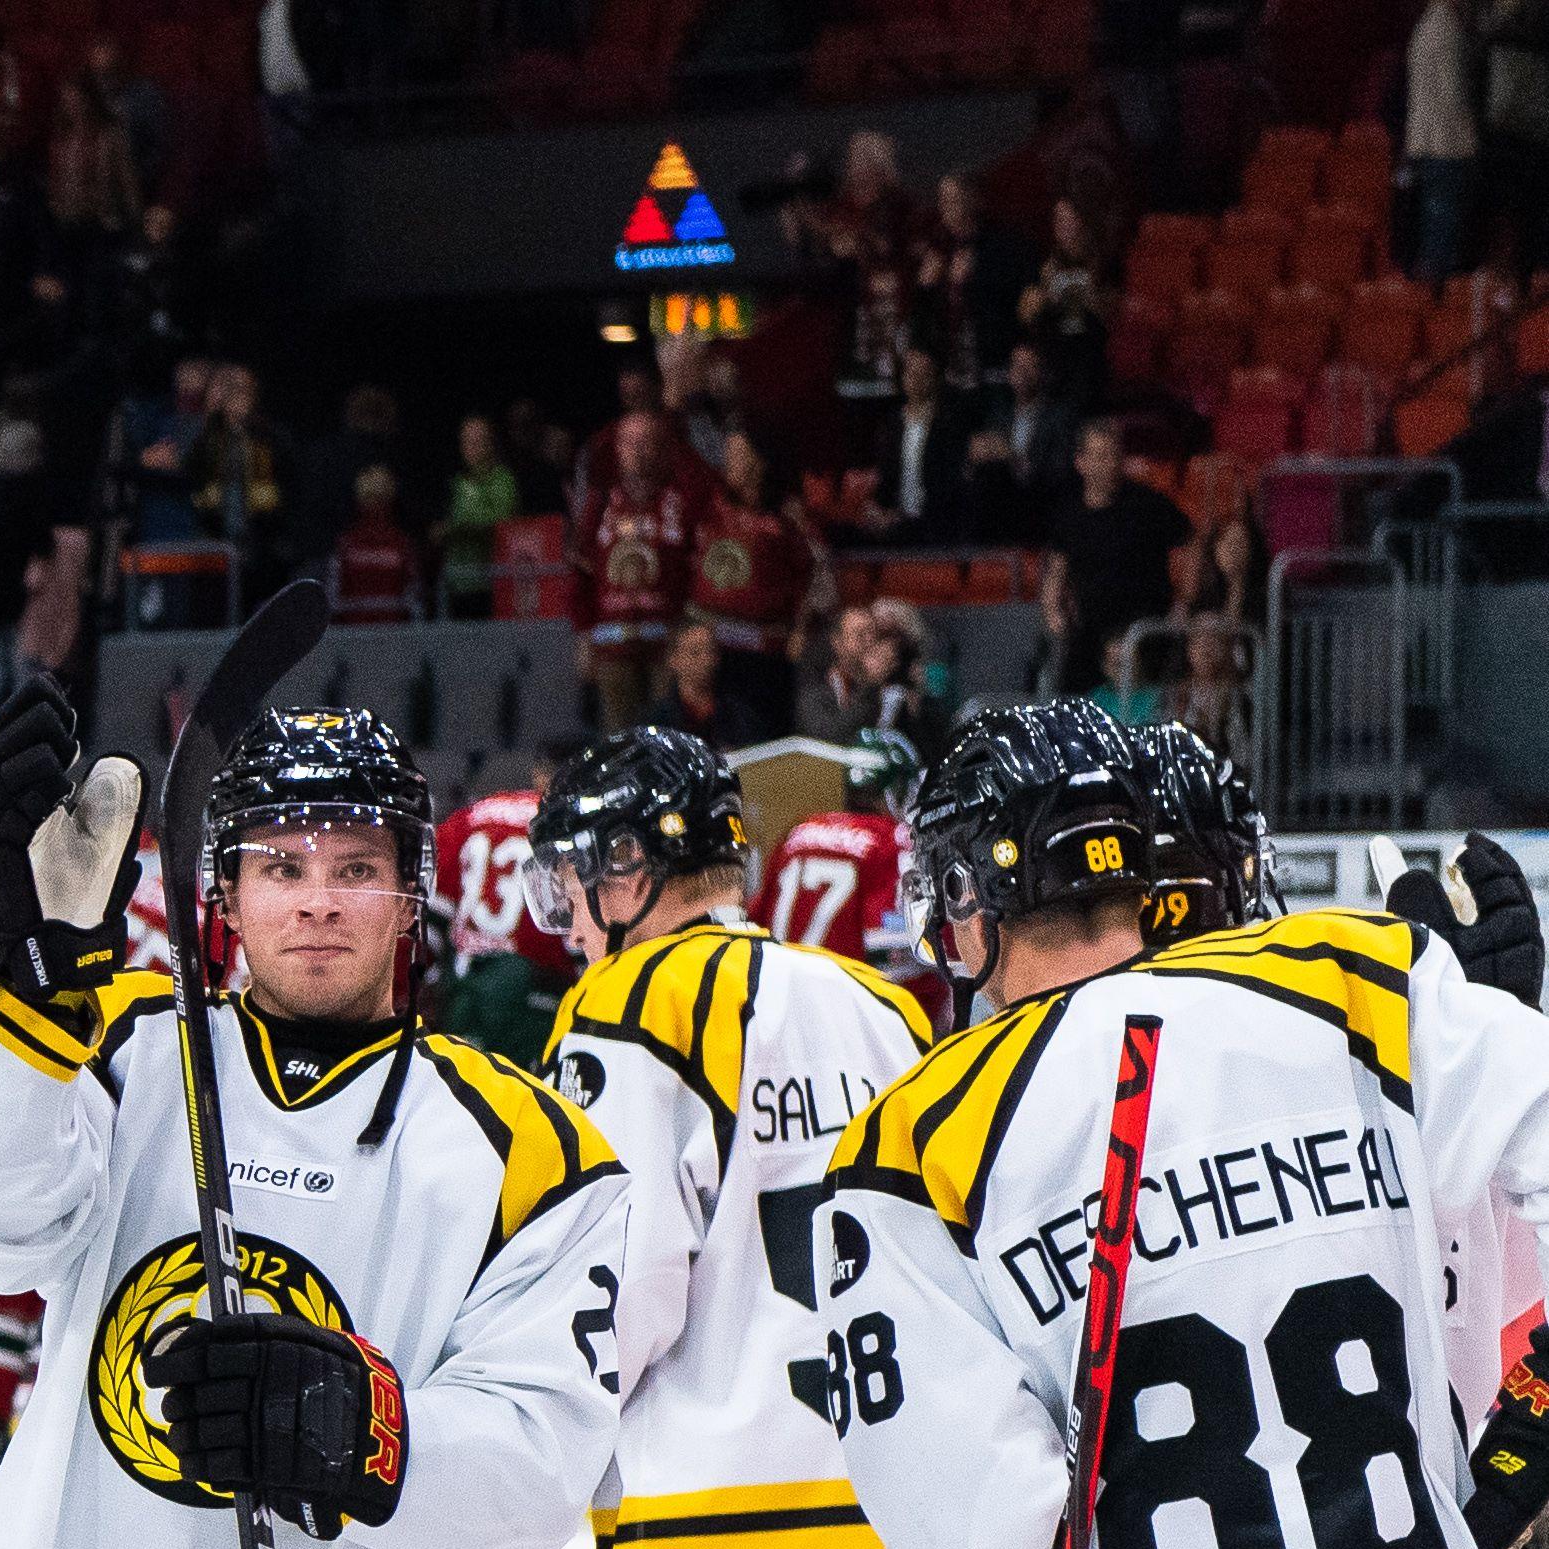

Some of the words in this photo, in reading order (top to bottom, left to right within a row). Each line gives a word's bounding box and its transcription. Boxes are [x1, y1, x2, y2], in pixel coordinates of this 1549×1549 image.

[1085, 836, 1123, 873] 88
[459, 830, 533, 939] 13
[772, 856, 857, 946] 17
[77, 949, 113, 968] BAUER
[169, 944, 187, 1016] BAUER
[228, 1159, 301, 1190] nicef
[236, 1246, 289, 1288] 912
